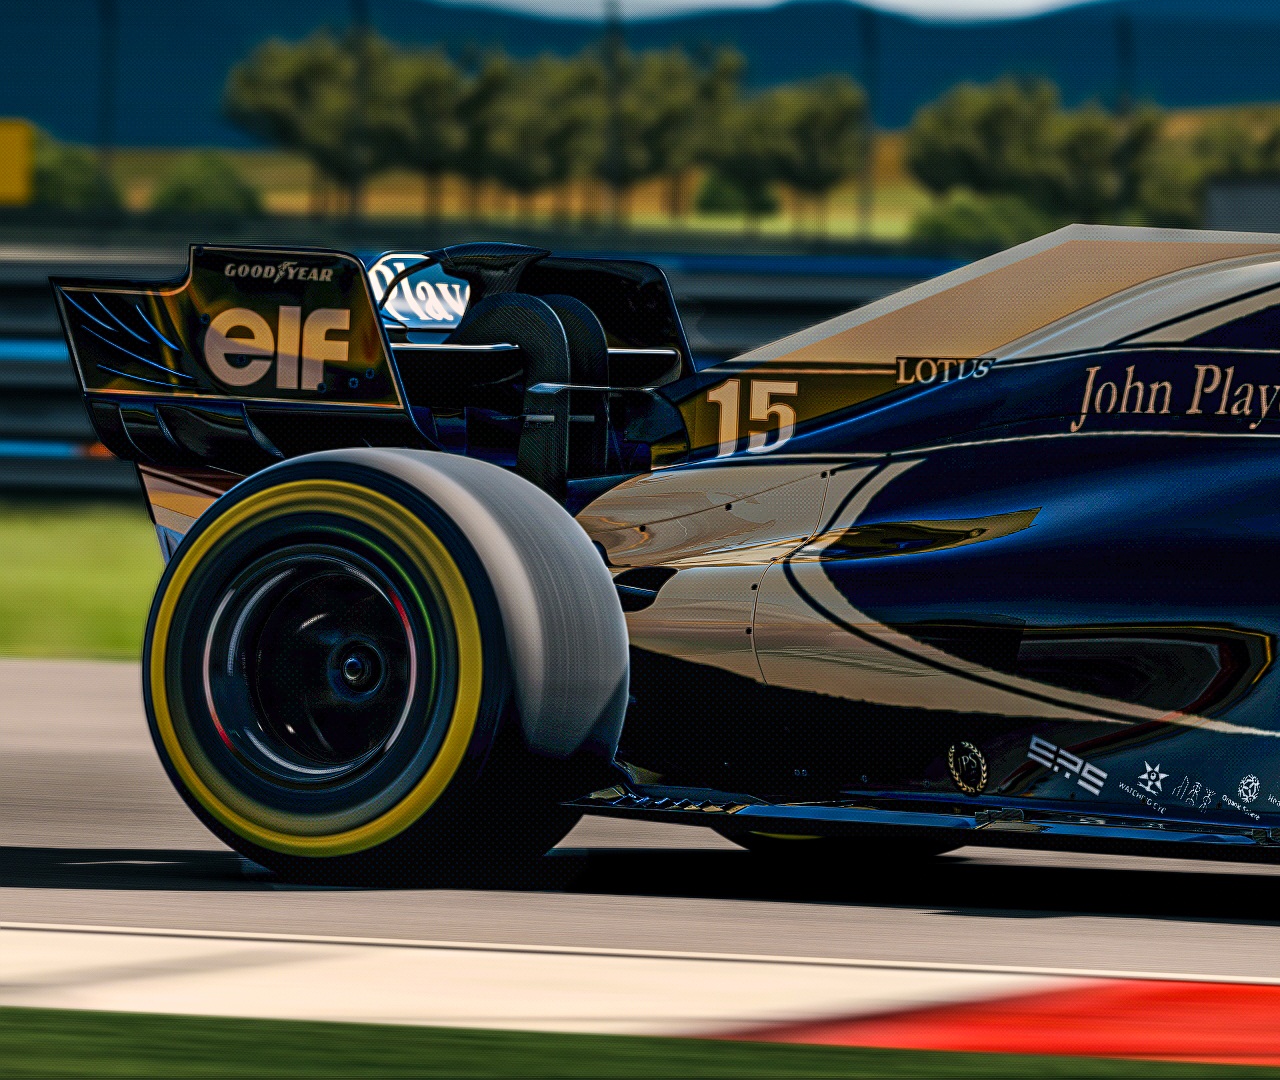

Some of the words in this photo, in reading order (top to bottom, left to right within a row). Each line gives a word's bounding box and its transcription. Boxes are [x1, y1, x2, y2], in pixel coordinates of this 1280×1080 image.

[224, 261, 334, 284] GOODYEAR
[203, 305, 350, 391] elf
[897, 358, 995, 385] LOTUS
[706, 378, 800, 460] 15
[1070, 365, 1173, 433] John
